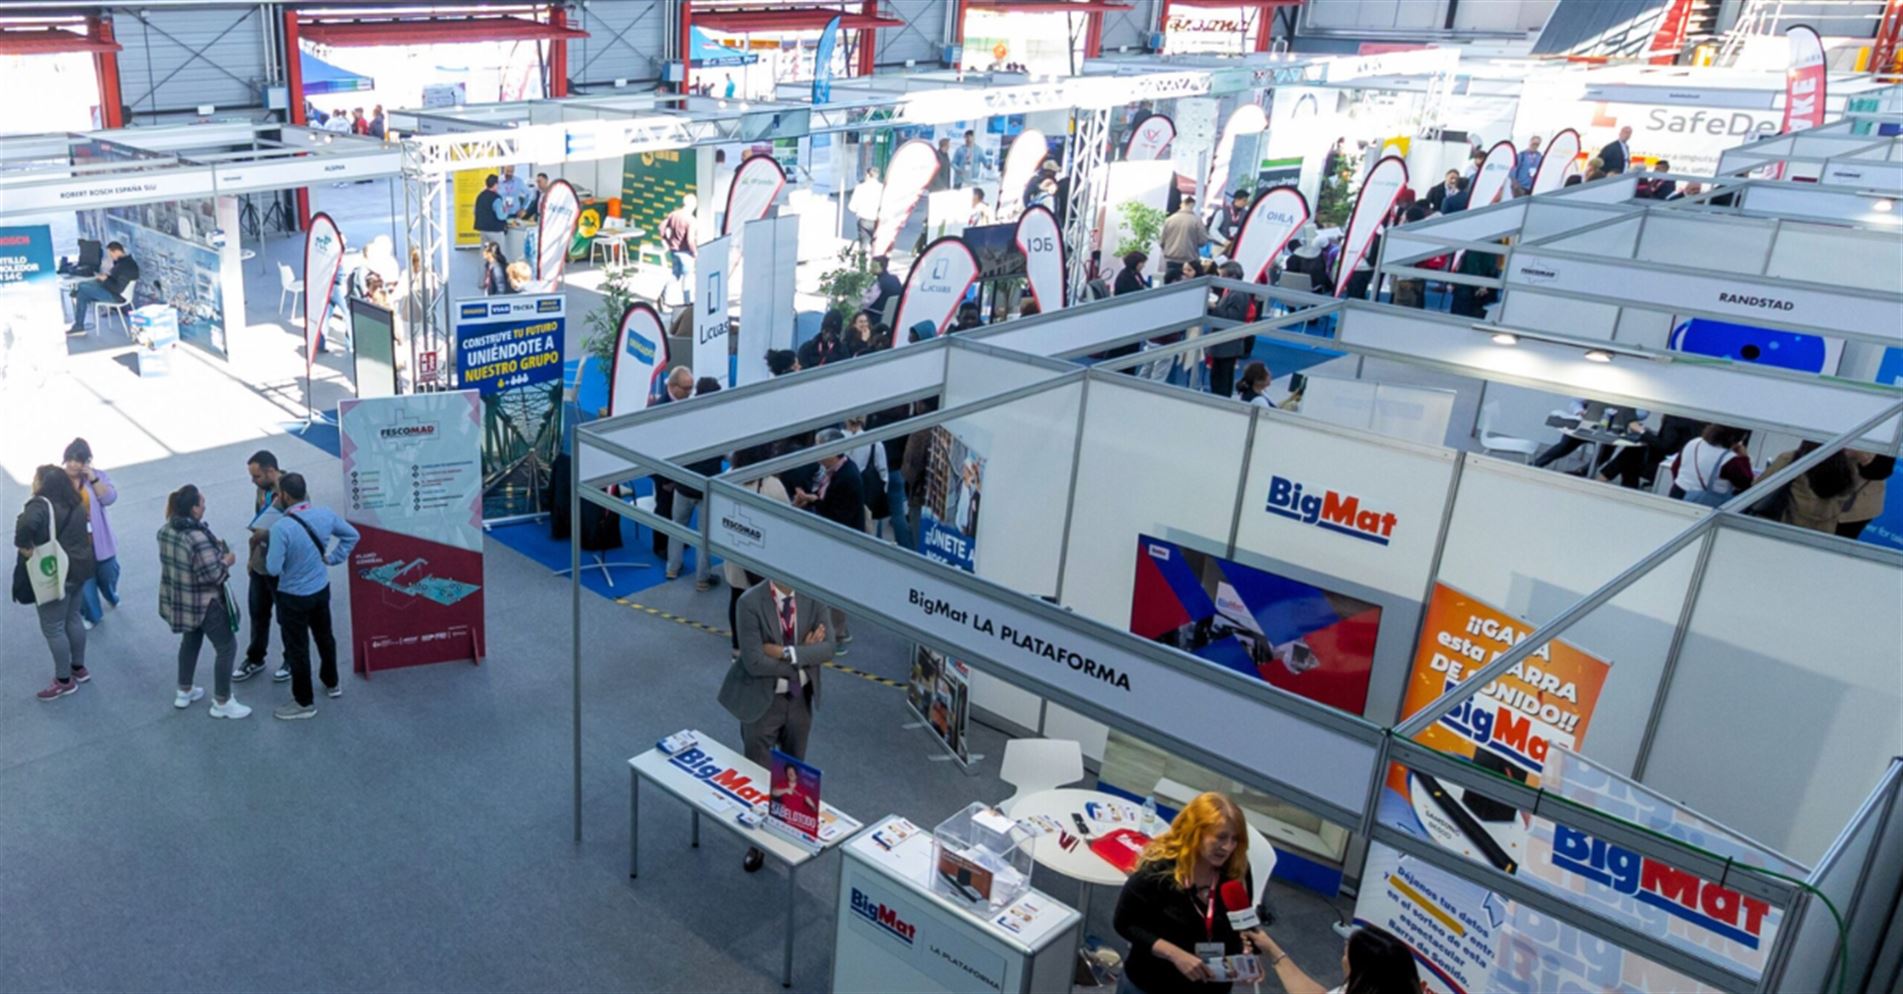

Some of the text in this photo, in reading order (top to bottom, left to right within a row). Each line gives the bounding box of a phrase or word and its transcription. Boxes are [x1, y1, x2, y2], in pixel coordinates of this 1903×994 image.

[1266, 210, 1295, 225] OHLA
[1719, 291, 1794, 312] RANDSTAD
[462, 321, 558, 350] CONSTRUYE TU FUTURO
[467, 335, 555, 367] UNIÉNDOTE A
[465, 350, 559, 383] NUESTRO GRUPO
[381, 425, 434, 437] FESCOMAD
[1267, 475, 1397, 538] BigMat
[722, 516, 762, 540] FESCOMAD
[908, 588, 1131, 692] BigMat LA PLATAFORMA
[1437, 630, 1486, 662] esta
[1430, 652, 1463, 681] DE
[1552, 822, 1770, 936] BigMat
[851, 886, 916, 941] BigMat
[1459, 912, 1489, 939] datos
[1400, 914, 1465, 967] espectacular
[1413, 908, 1446, 936] sorteo
[1447, 935, 1461, 948] de
[1463, 947, 1487, 968] esta
[929, 944, 1000, 991] LA PLATAFORMA
